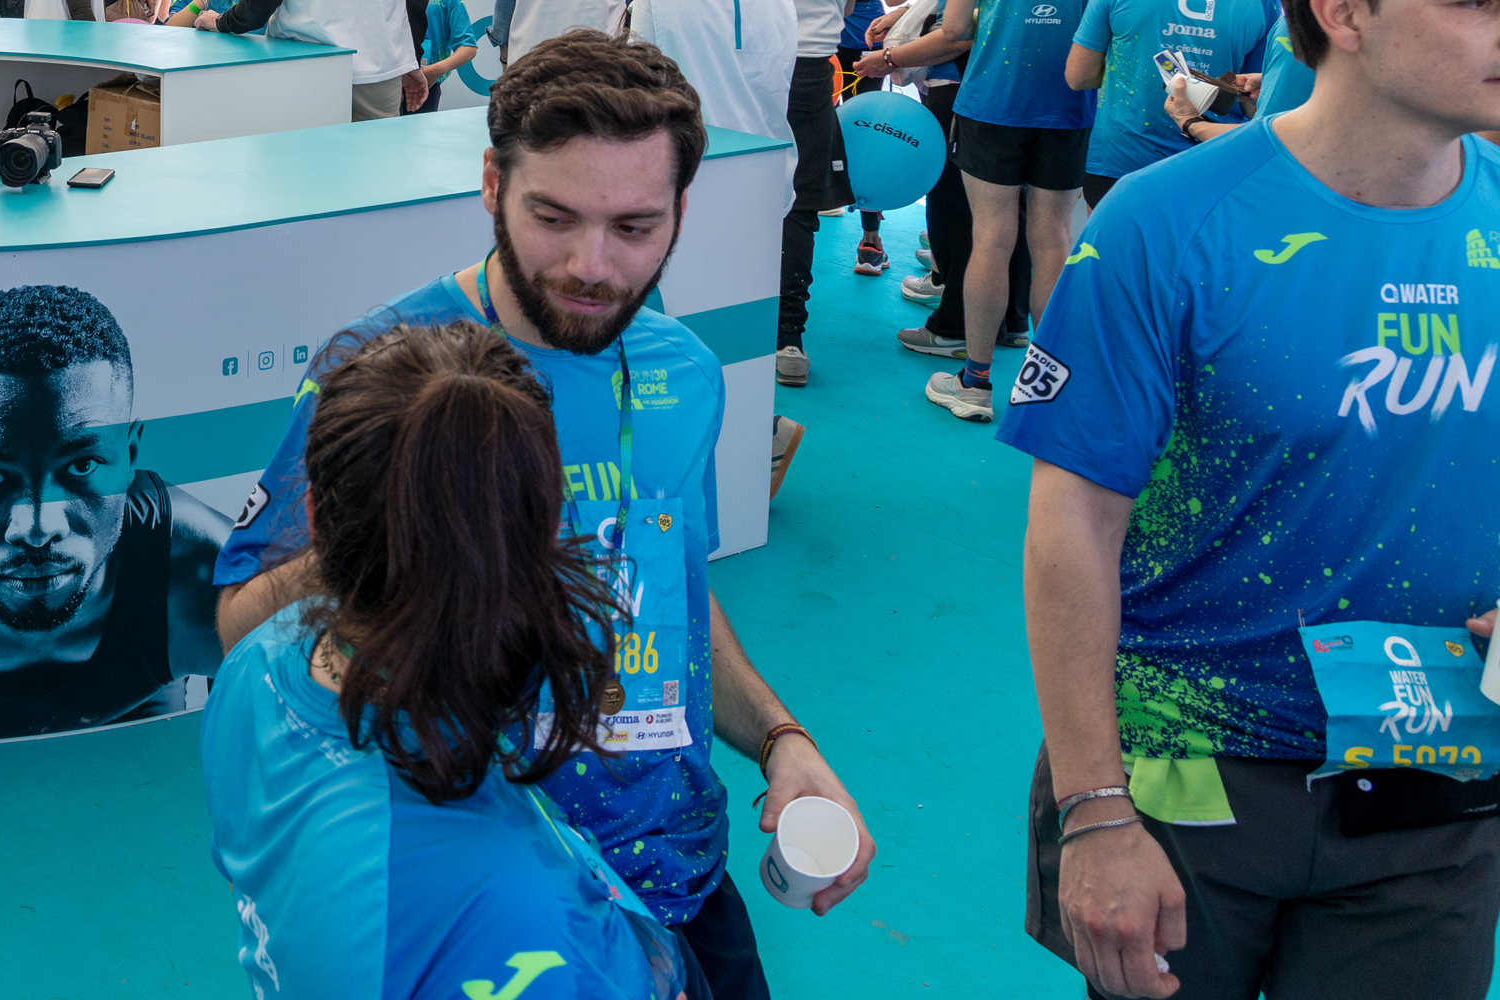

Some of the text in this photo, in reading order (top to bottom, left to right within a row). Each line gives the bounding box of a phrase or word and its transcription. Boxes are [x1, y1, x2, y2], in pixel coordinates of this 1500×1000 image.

[1162, 22, 1216, 39] Joma
[1176, 43, 1214, 56] cisalfa
[874, 122, 920, 148] cisalfa
[1400, 284, 1460, 304] WATER
[1377, 312, 1460, 355] FUN
[1028, 348, 1058, 372] RADIO
[630, 369, 668, 382] RUN30
[1019, 360, 1059, 398] 05
[638, 382, 668, 395] ROME
[1335, 343, 1498, 438] RUN
[1389, 670, 1428, 686] WATER
[1392, 684, 1435, 706] FUN
[612, 715, 640, 725] Joma
[1378, 698, 1453, 743] RUN
